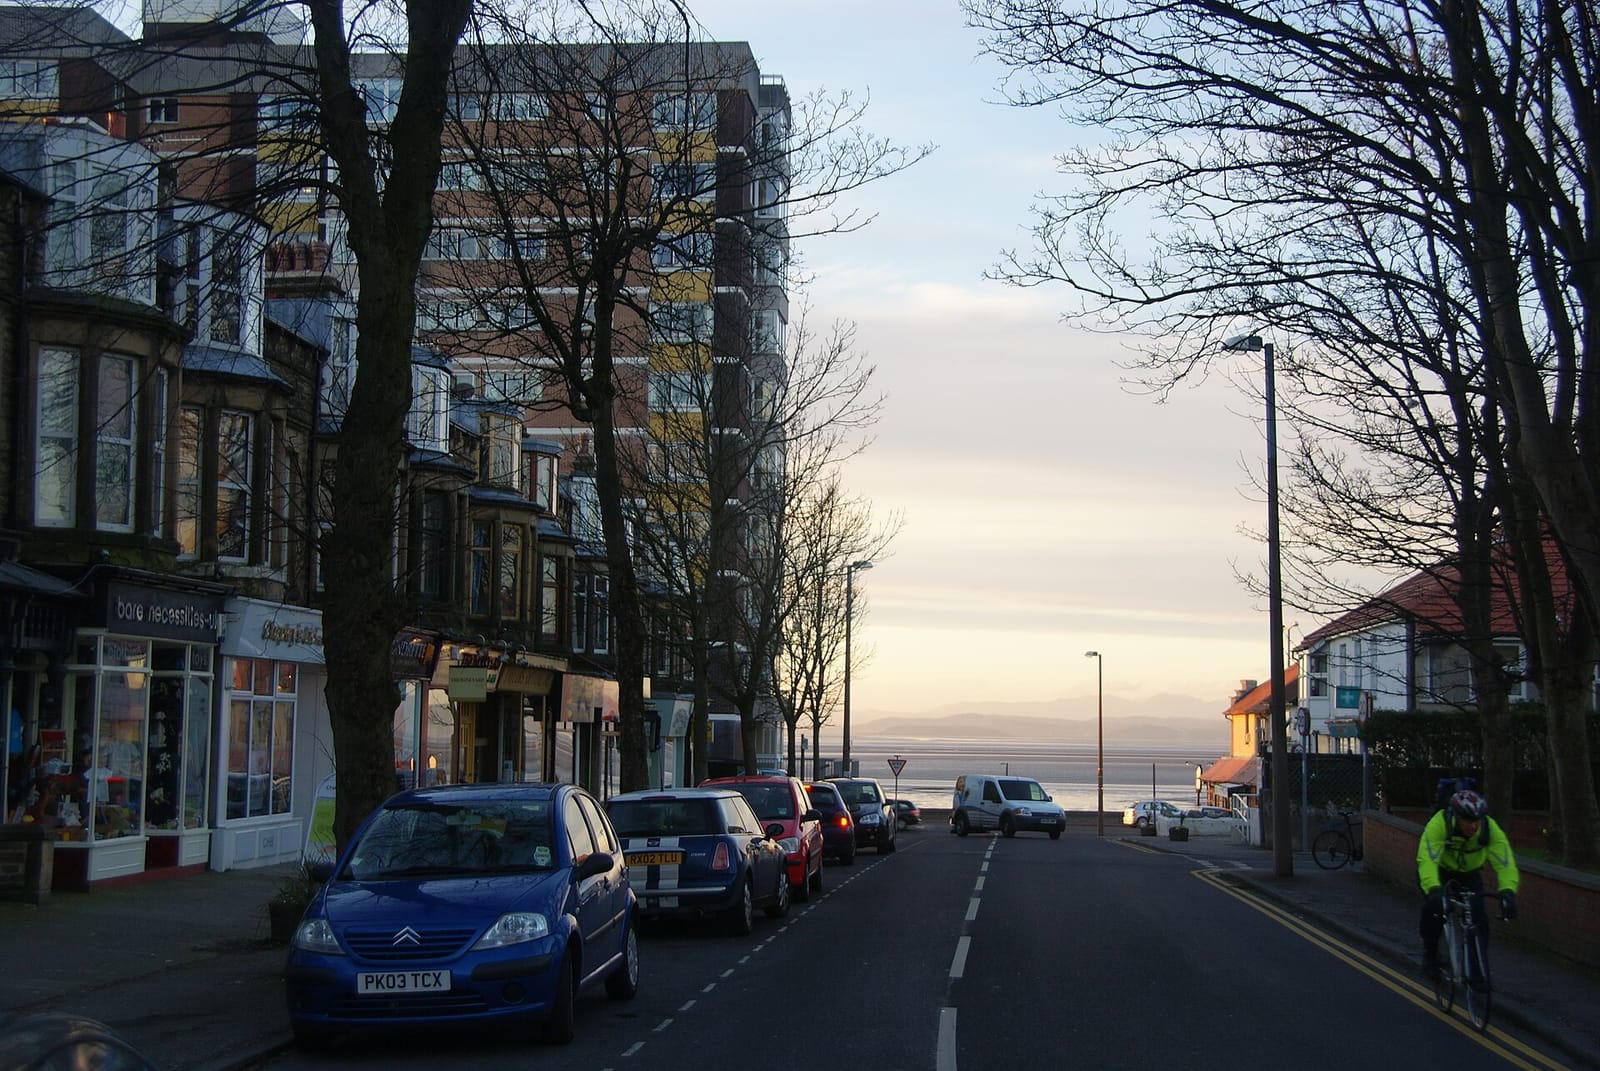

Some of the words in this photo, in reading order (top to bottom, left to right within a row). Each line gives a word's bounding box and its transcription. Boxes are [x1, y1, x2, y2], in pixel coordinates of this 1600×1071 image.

[117, 596, 144, 621] bare
[630, 854, 656, 865] RX02
[659, 852, 678, 864] TLU
[364, 974, 406, 990] PK03
[411, 972, 442, 988] TCX
